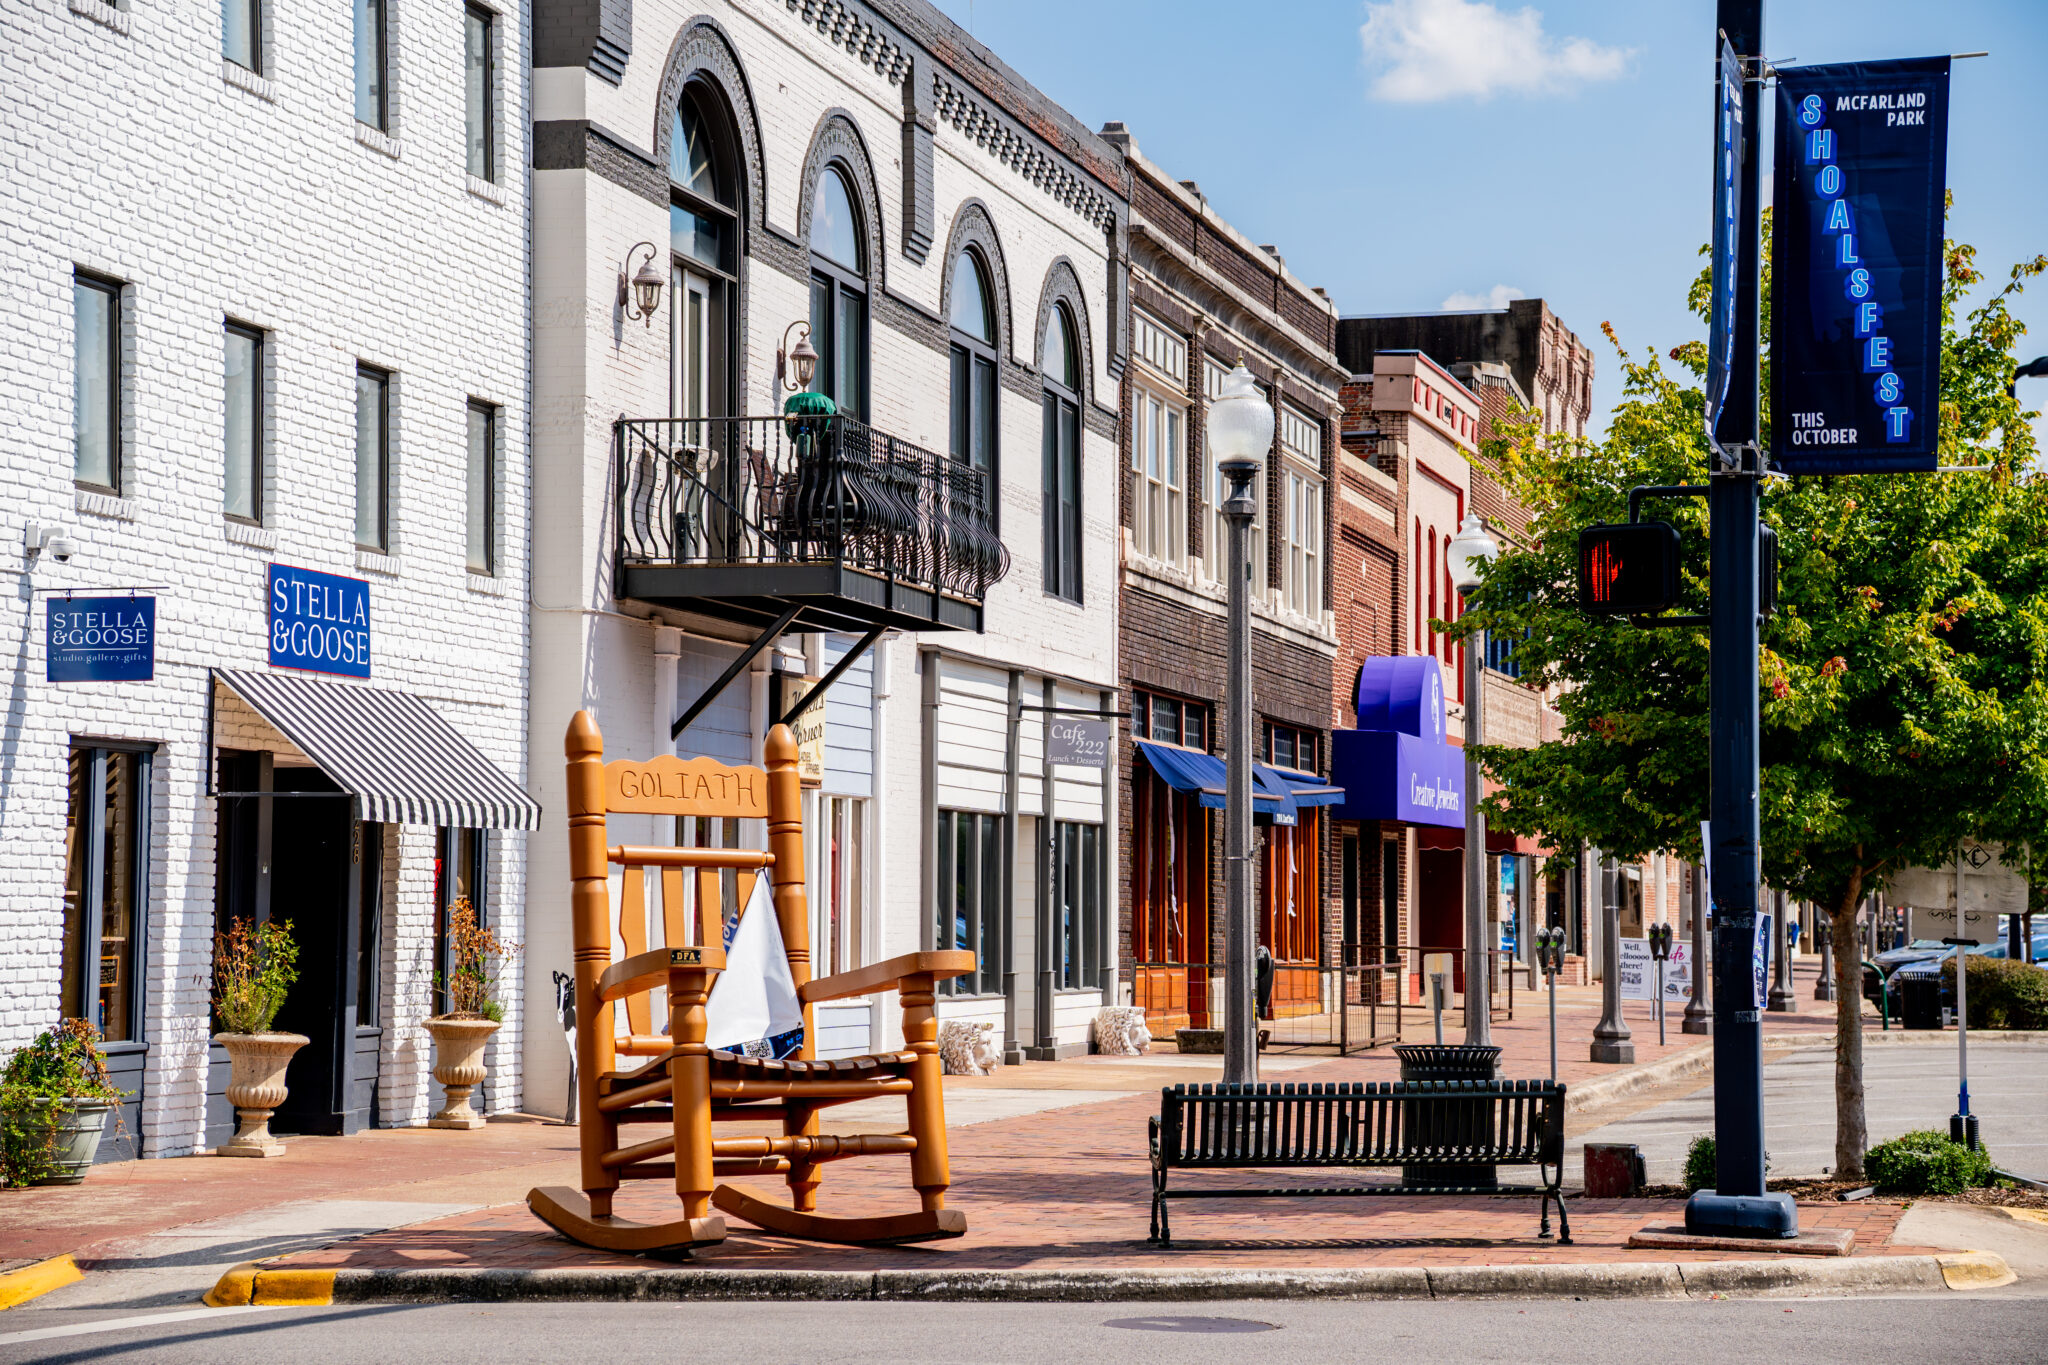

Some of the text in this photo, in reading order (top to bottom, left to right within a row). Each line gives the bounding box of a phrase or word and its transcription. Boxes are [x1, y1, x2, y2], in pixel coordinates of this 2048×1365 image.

[1836, 92, 1926, 111] MCFARLAND
[1887, 110, 1925, 127] PARK
[1791, 411, 1825, 428] THIS
[1792, 428, 1858, 445] OCTOBER
[274, 577, 367, 626] STELLA
[53, 611, 147, 629] STELLA
[52, 628, 148, 645] &GOOSE
[273, 618, 368, 665] &GOOSE
[1051, 724, 1086, 746] Cafe
[1074, 740, 1105, 756] 222
[620, 770, 757, 808] GOLIATH
[1411, 772, 1436, 808] Creative
[676, 951, 696, 960] DFA
